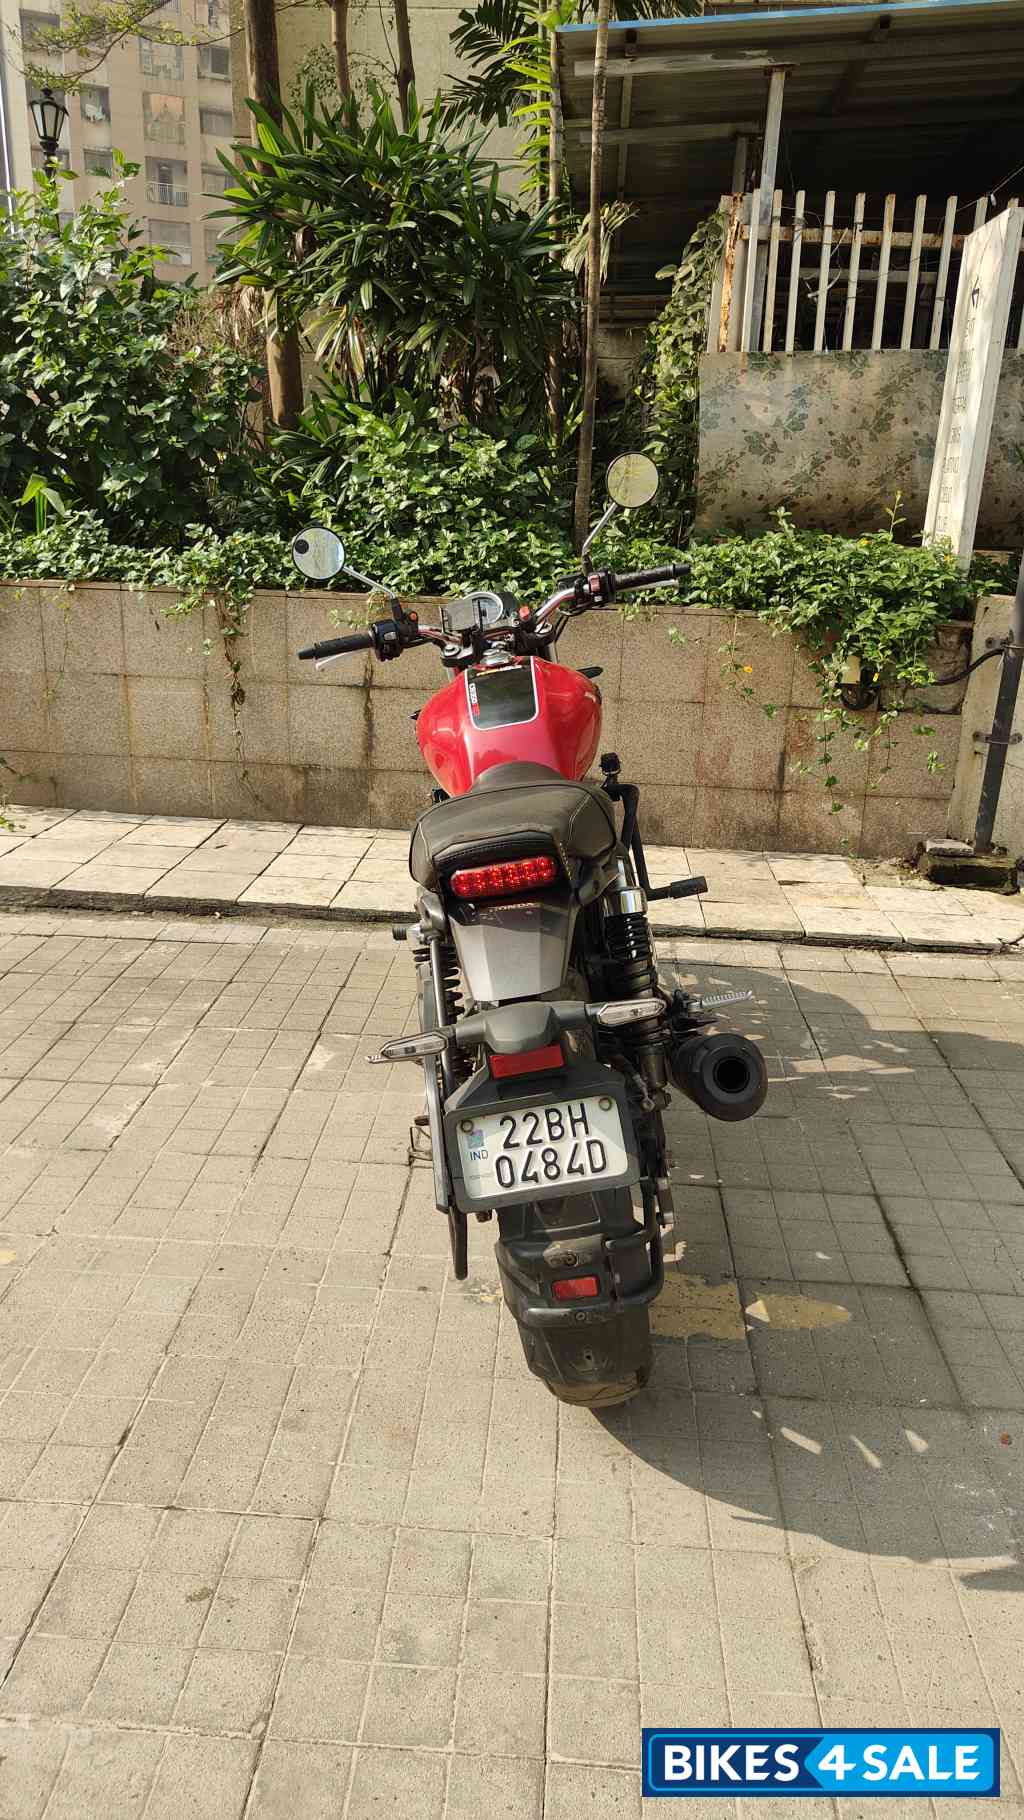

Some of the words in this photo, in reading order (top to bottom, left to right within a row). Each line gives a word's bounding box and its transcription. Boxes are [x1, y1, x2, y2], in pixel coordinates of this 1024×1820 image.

[500, 1103, 589, 1149] 22BH
[470, 1150, 488, 1160] IND
[495, 1139, 606, 1188] 0484D
